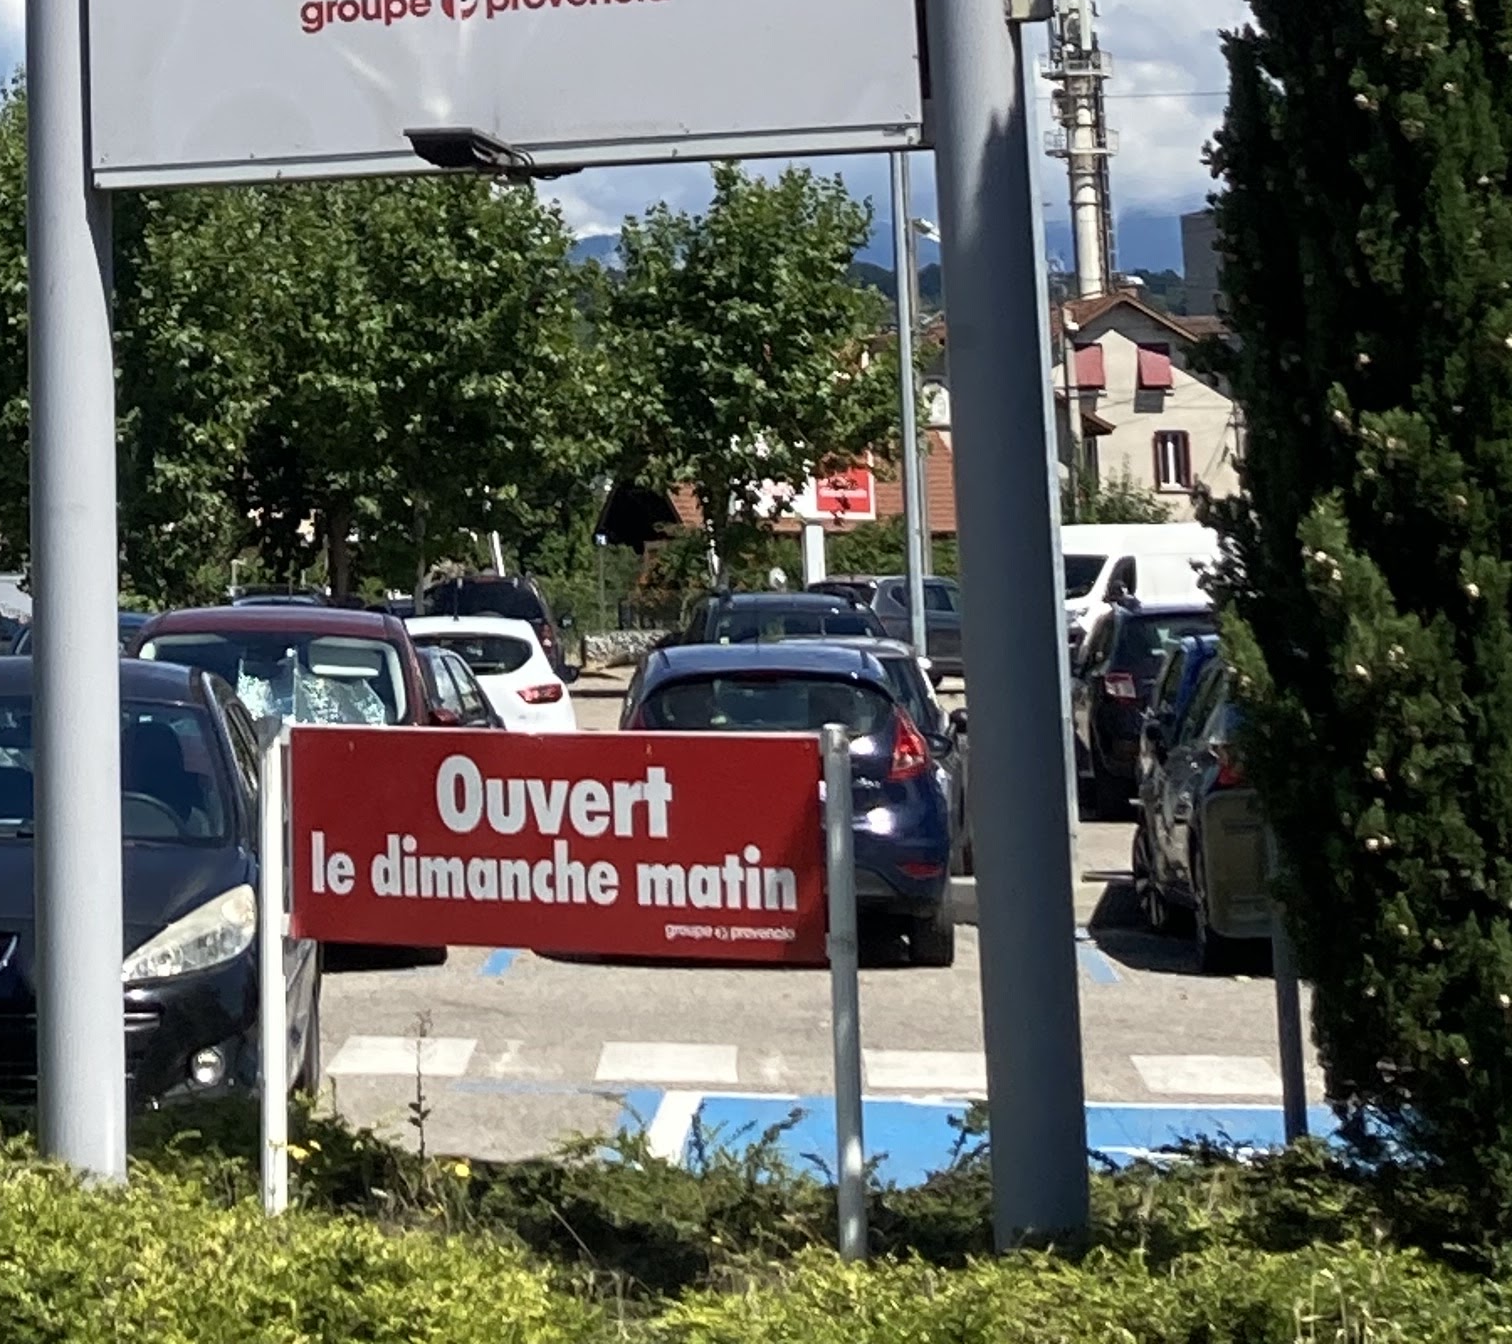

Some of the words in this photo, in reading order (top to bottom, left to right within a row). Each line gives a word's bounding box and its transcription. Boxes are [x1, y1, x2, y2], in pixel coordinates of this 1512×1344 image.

[435, 754, 674, 839] Ouvert
[310, 830, 356, 896] le
[371, 833, 620, 906] dimanche
[636, 844, 798, 912] matin
